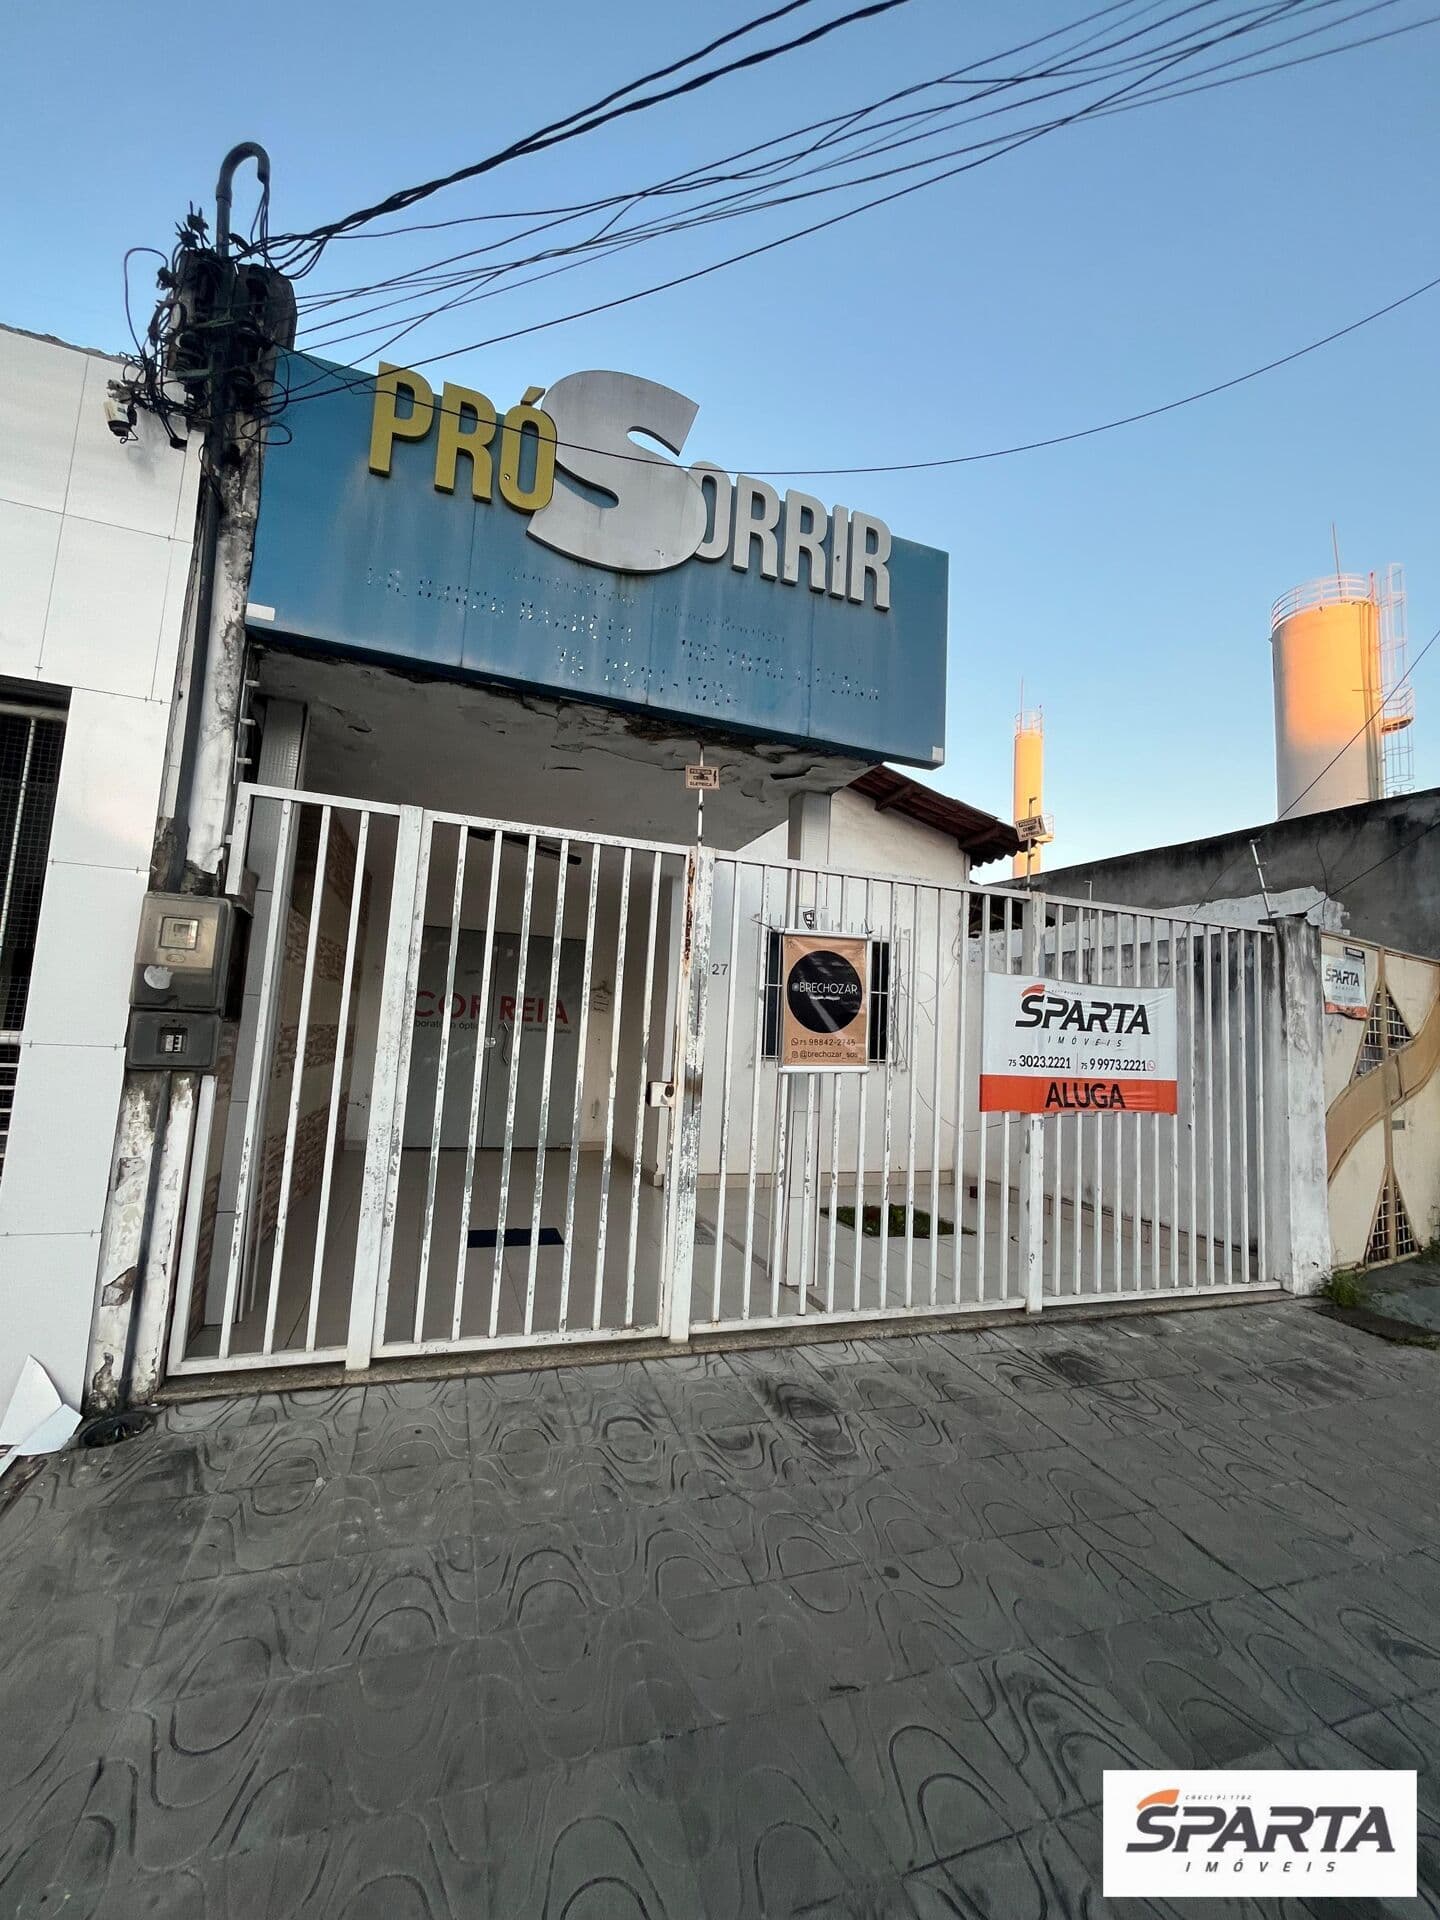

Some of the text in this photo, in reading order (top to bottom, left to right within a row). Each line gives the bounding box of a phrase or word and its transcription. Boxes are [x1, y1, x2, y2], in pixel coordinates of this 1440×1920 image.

[368, 361, 558, 514] PRÓ
[711, 963, 729, 976] 27
[1324, 968, 1360, 987] SPARTA
[1015, 994, 1151, 1035] SPARTA
[1047, 1036, 1123, 1048] IMÓVEIS
[1008, 1059, 1017, 1067] 75
[1019, 1055, 1071, 1069] 3023.2221
[1081, 1062, 1088, 1070] 75
[1097, 1059, 1147, 1071] 9973.2221
[1045, 1082, 1126, 1109] ALUGA
